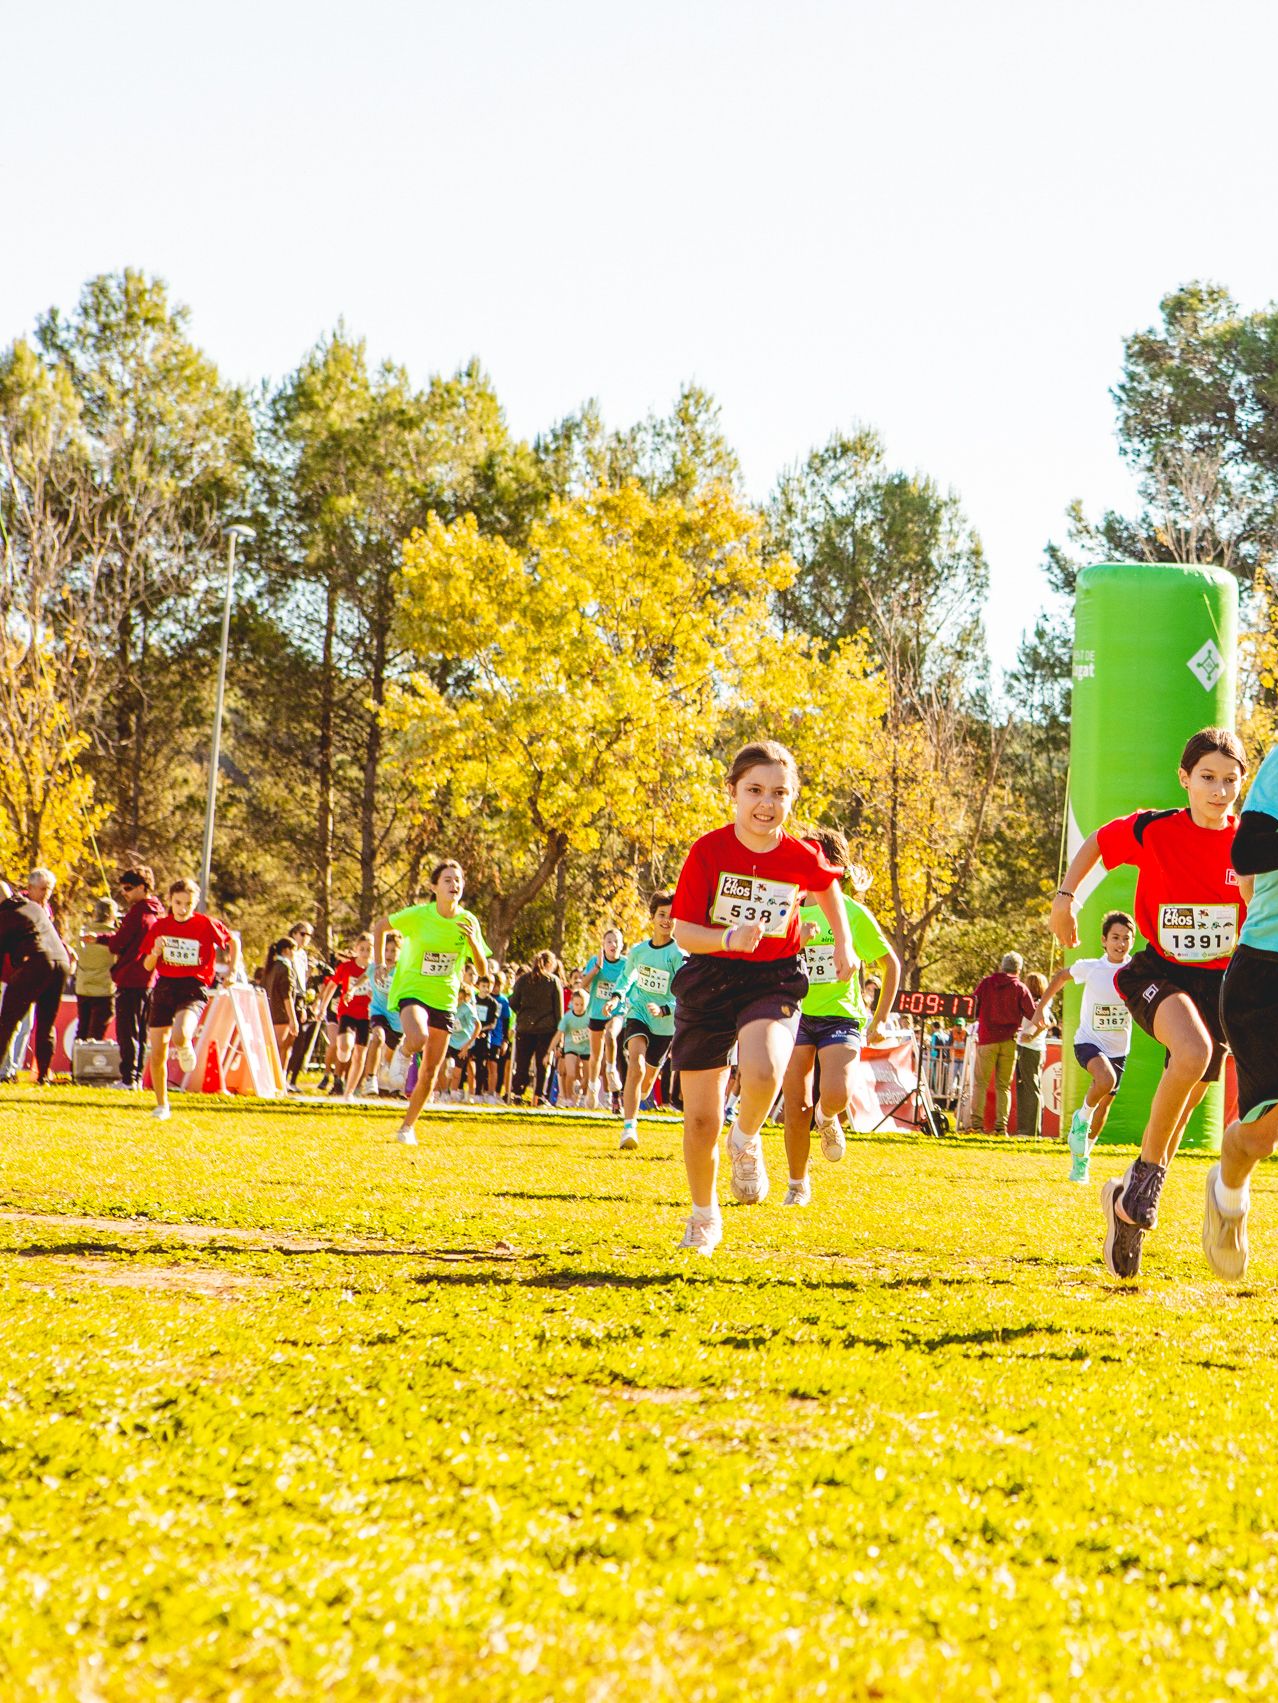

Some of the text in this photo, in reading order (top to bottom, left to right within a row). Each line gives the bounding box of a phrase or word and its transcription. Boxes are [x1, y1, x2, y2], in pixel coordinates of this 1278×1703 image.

[723, 885, 751, 898] CROS
[730, 904, 772, 924] 538
[1164, 915, 1193, 926] CROS
[1172, 934, 1222, 950] 1391
[899, 993, 974, 1016] 1:09:17
[1099, 1018, 1125, 1026] 3167
